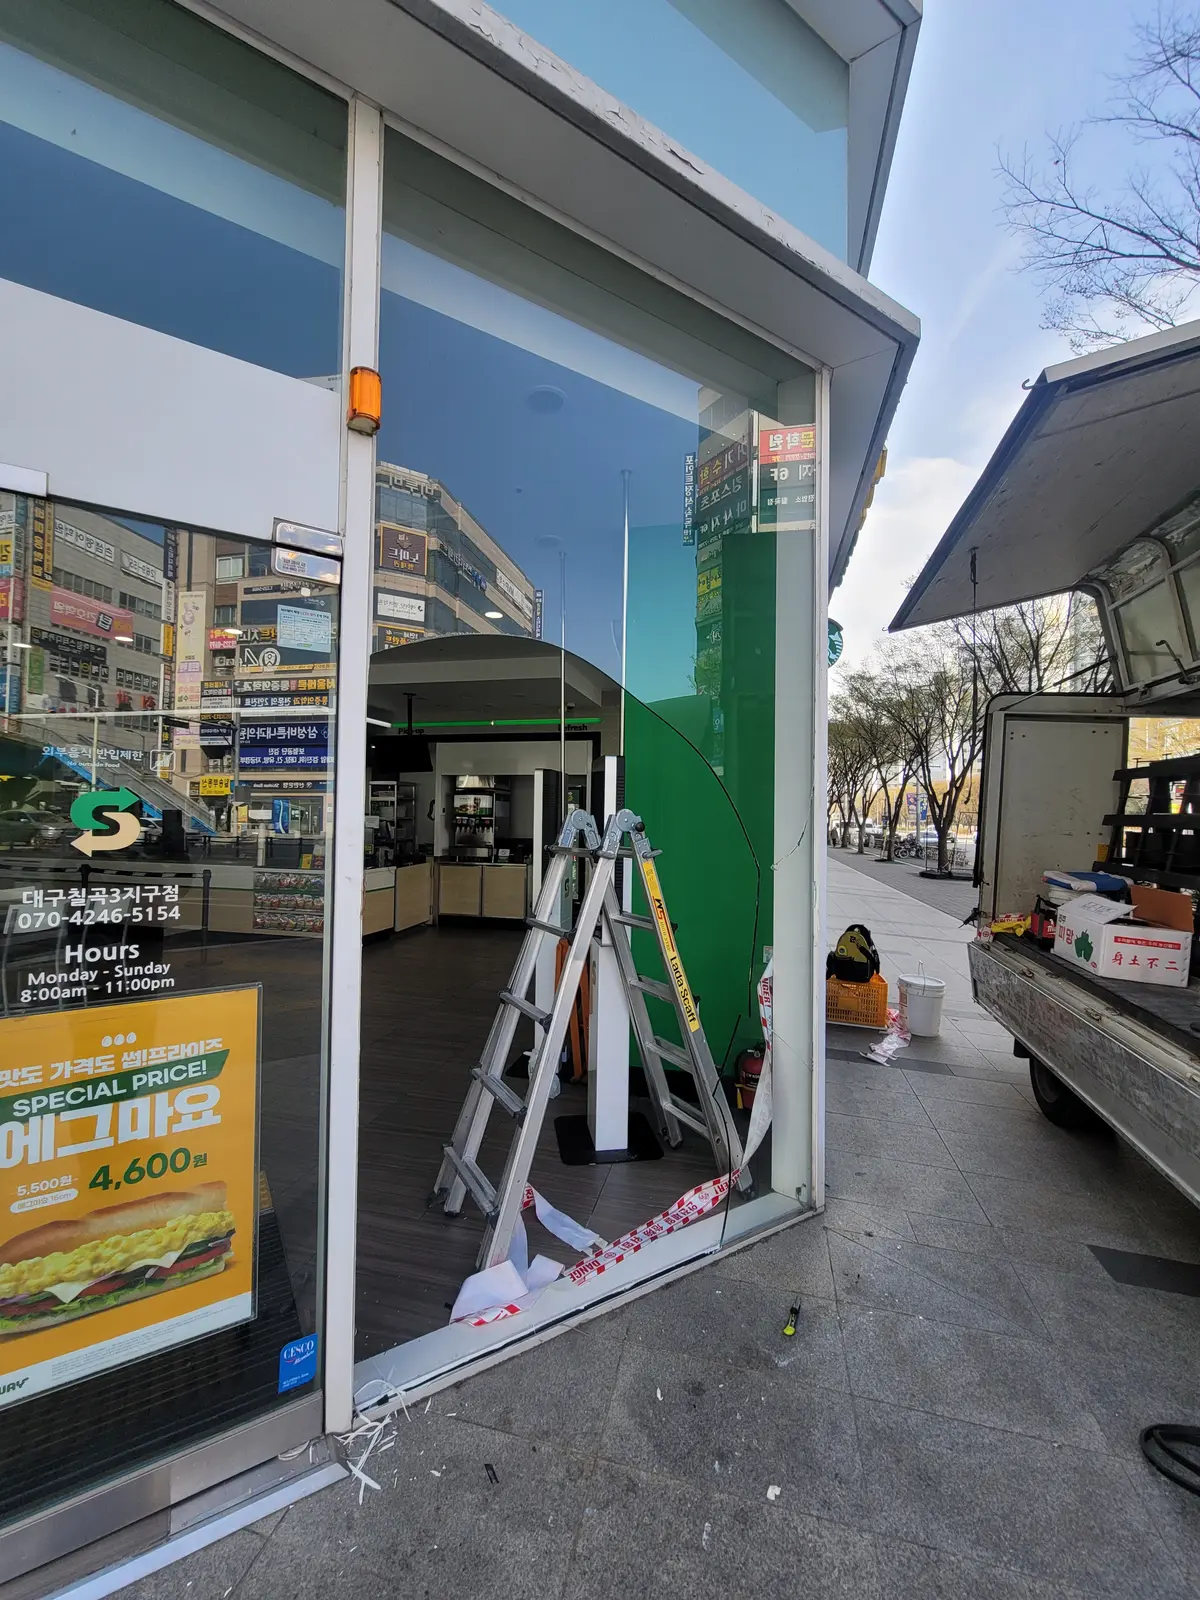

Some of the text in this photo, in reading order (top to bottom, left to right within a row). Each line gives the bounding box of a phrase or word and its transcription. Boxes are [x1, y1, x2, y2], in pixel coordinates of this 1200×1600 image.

[42, 746, 143, 761] 외부음식 반입제한
[22, 885, 180, 908] 대구칠곡3지구점
[17, 905, 181, 929] 070-4246-5154
[64, 944, 140, 964] Hours
[1111, 951, 1179, 971] 身土不二
[28, 968, 98, 986] Monday
[114, 962, 171, 978] Sunday
[20, 986, 87, 1003] 8:00am
[105, 977, 175, 995] 11:00pm
[0, 1064, 43, 1089] 맛도
[50, 1054, 115, 1080] 가격도
[13, 1059, 207, 1117] SPECIAL PRICE!
[0, 1084, 222, 1169] 에그마요
[88, 1147, 208, 1192] 4,600원
[283, 1340, 314, 1360] CESCO
